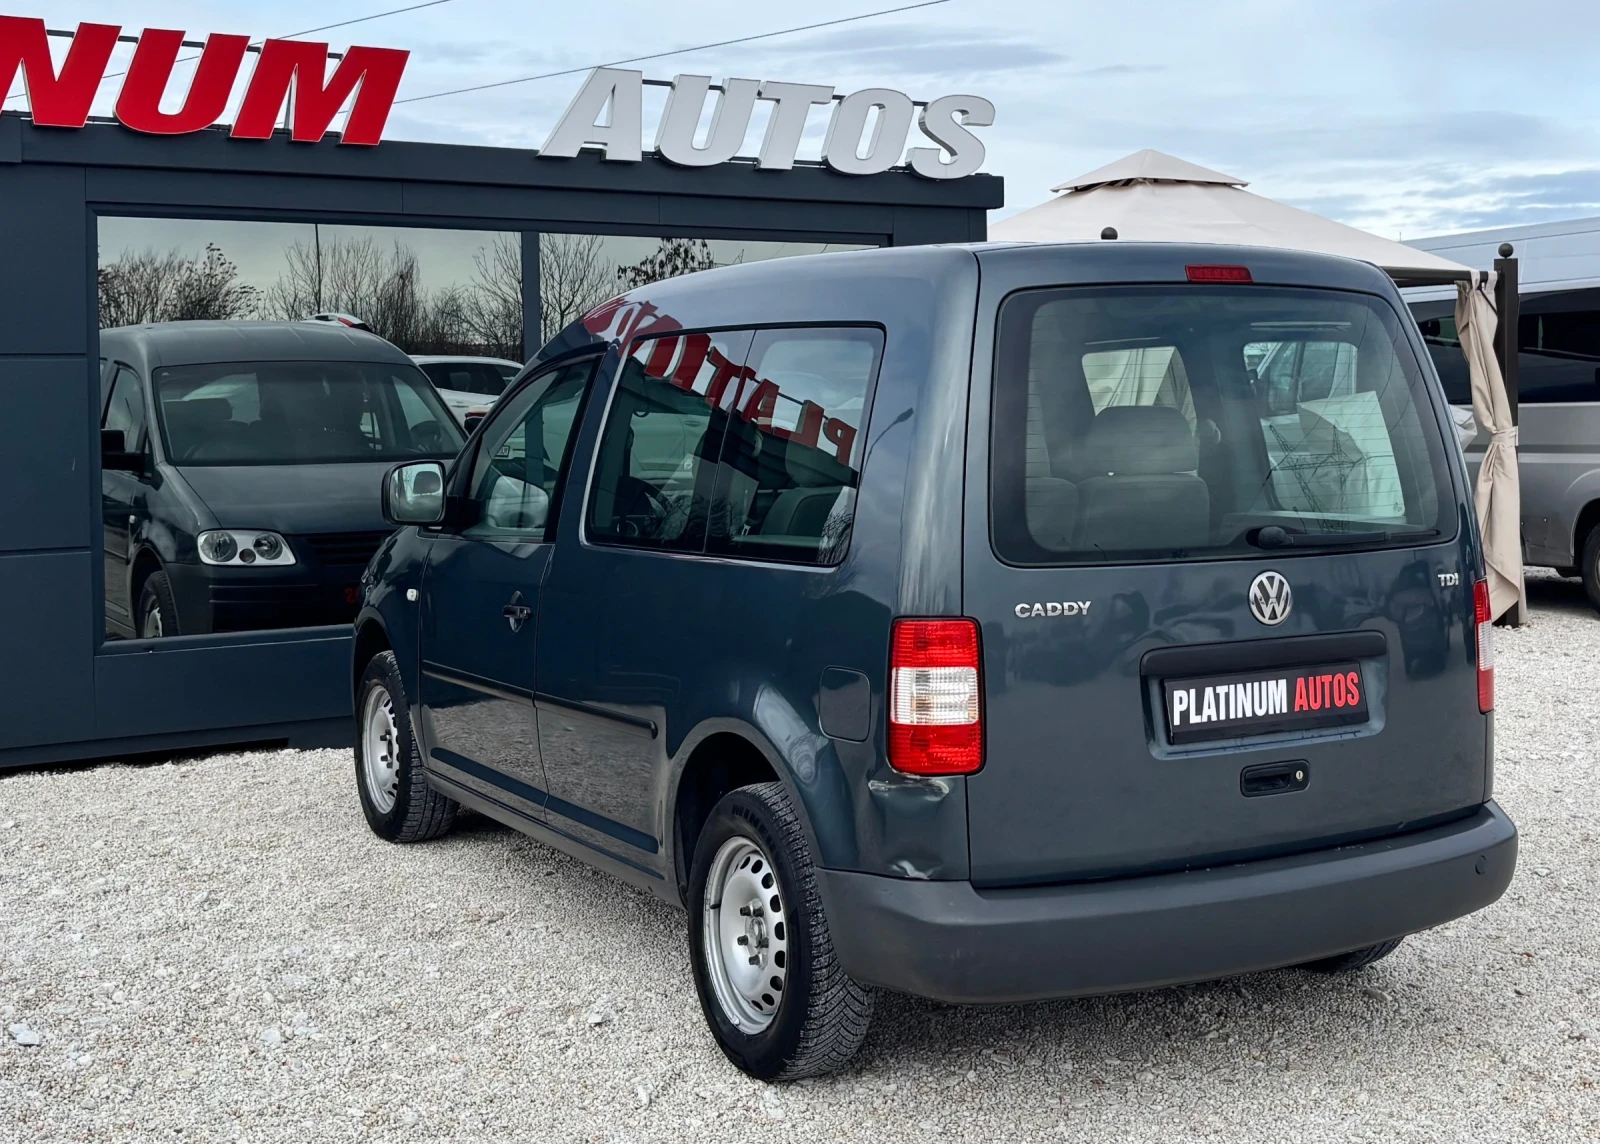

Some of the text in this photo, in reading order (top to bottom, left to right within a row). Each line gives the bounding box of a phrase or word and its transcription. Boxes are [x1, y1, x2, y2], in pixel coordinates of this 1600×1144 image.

[537, 66, 996, 180] AUTOS
[1437, 572, 1459, 587] TDI
[1014, 600, 1092, 618] CADDY
[1173, 671, 1360, 726] PLATINUM AUTOS
